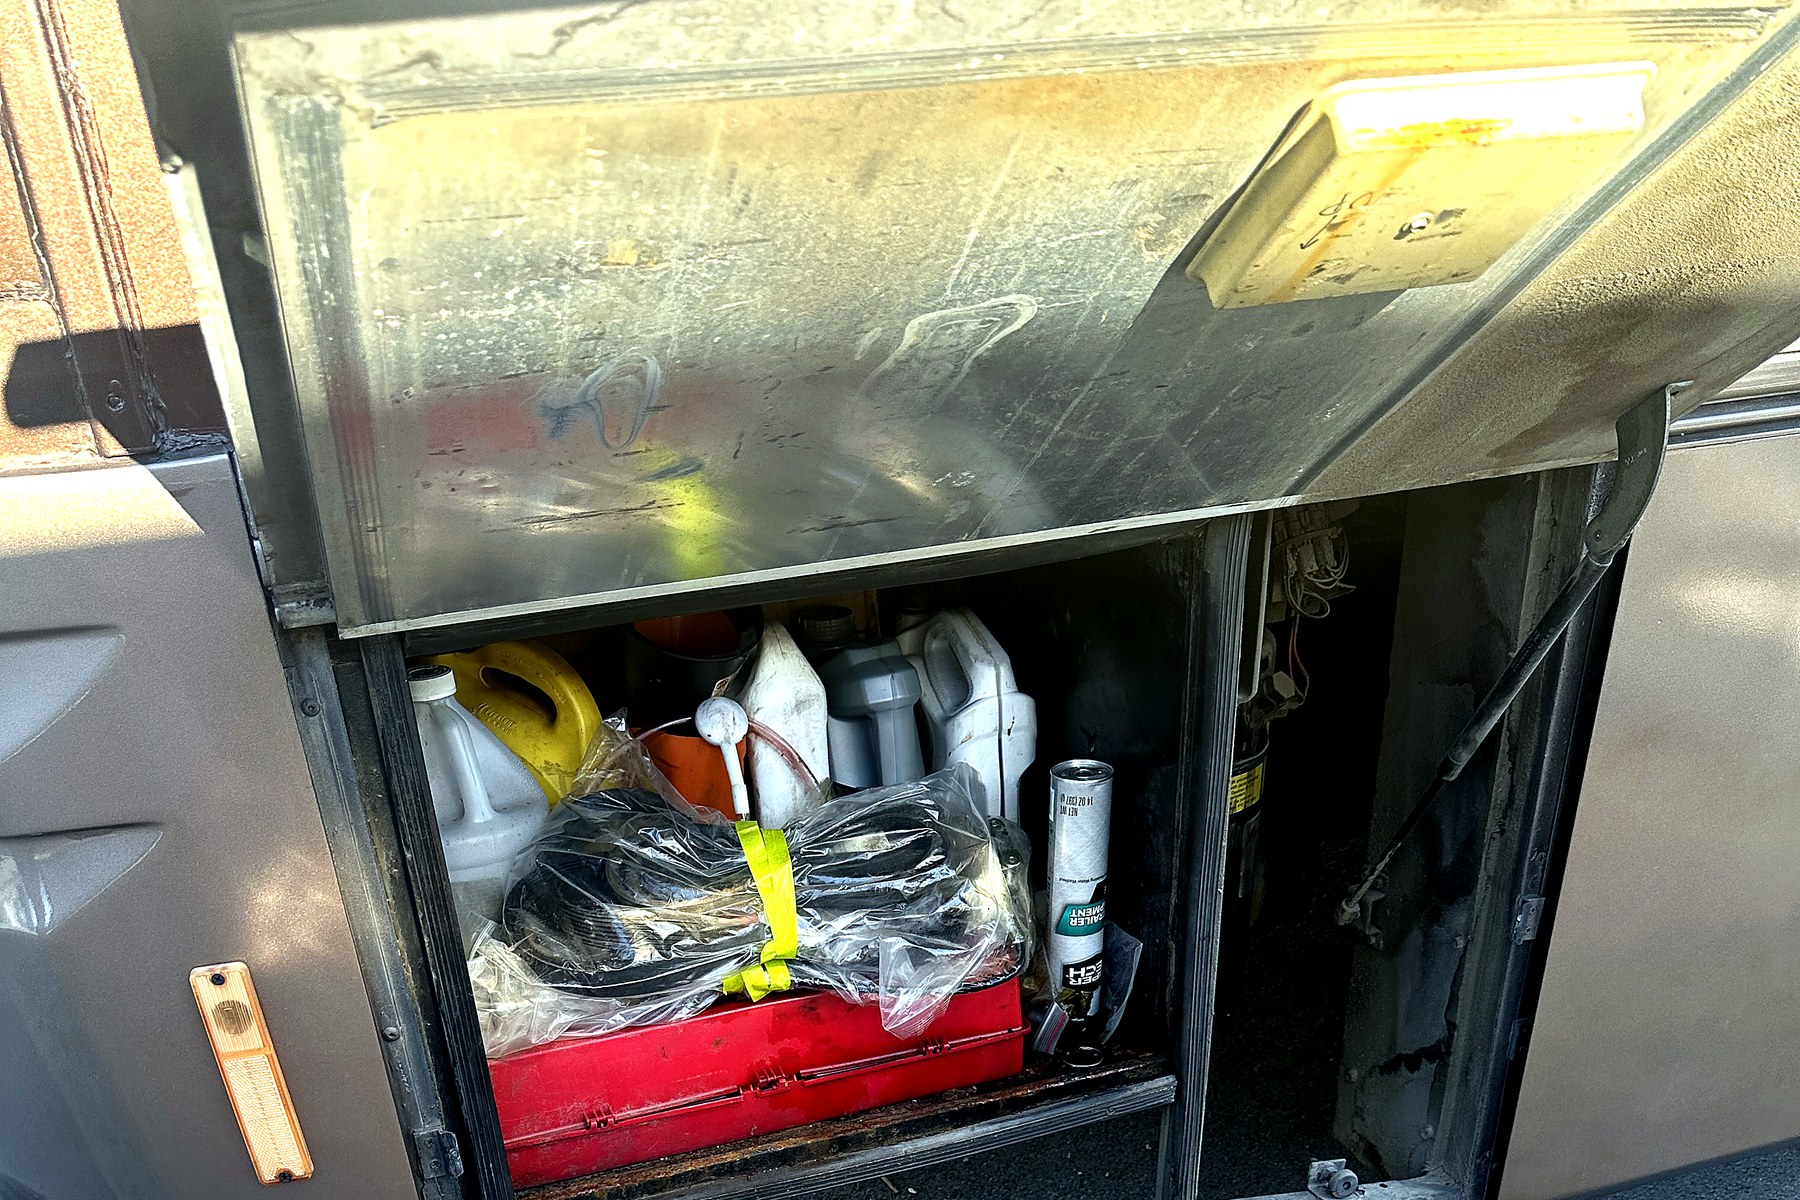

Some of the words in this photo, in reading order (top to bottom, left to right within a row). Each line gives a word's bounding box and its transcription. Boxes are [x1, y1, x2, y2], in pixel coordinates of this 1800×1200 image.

[1078, 796, 1086, 806] OZ
[1087, 796, 1094, 806] 14
[1068, 808, 1078, 816] NET
